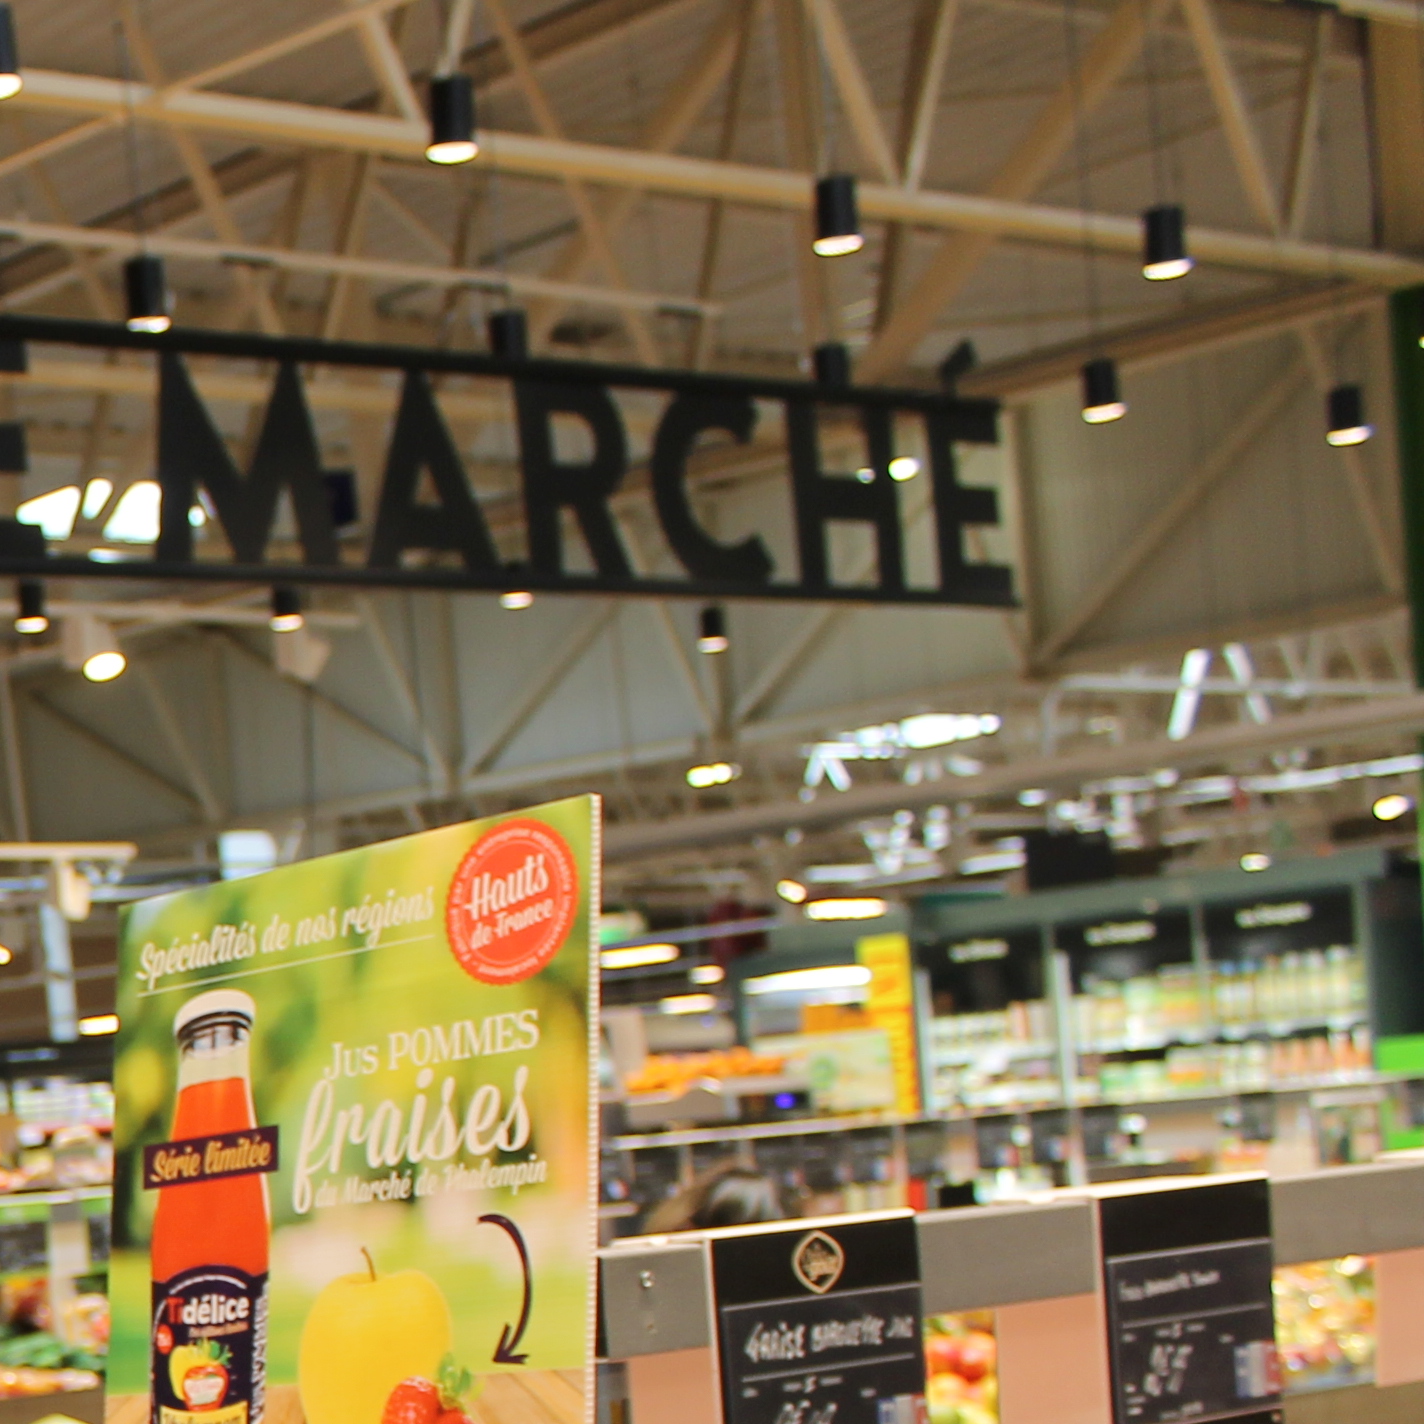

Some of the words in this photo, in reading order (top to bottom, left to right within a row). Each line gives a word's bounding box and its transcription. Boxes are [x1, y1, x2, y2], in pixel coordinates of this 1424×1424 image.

[157, 342, 1014, 592] MARCHÉ
[464, 853, 550, 921] Hauts
[135, 920, 257, 991] Spécialités
[261, 913, 291, 954] de
[294, 907, 337, 947] nos
[341, 885, 435, 949] régions
[470, 922, 494, 950] de
[494, 898, 554, 939] France
[387, 1009, 540, 1071] POMMES
[150, 1145, 202, 1182] Série
[203, 1131, 271, 1175] limitée
[292, 1065, 531, 1215] fraises
[415, 1167, 440, 1197] de
[166, 1293, 250, 1325] Tidélice
